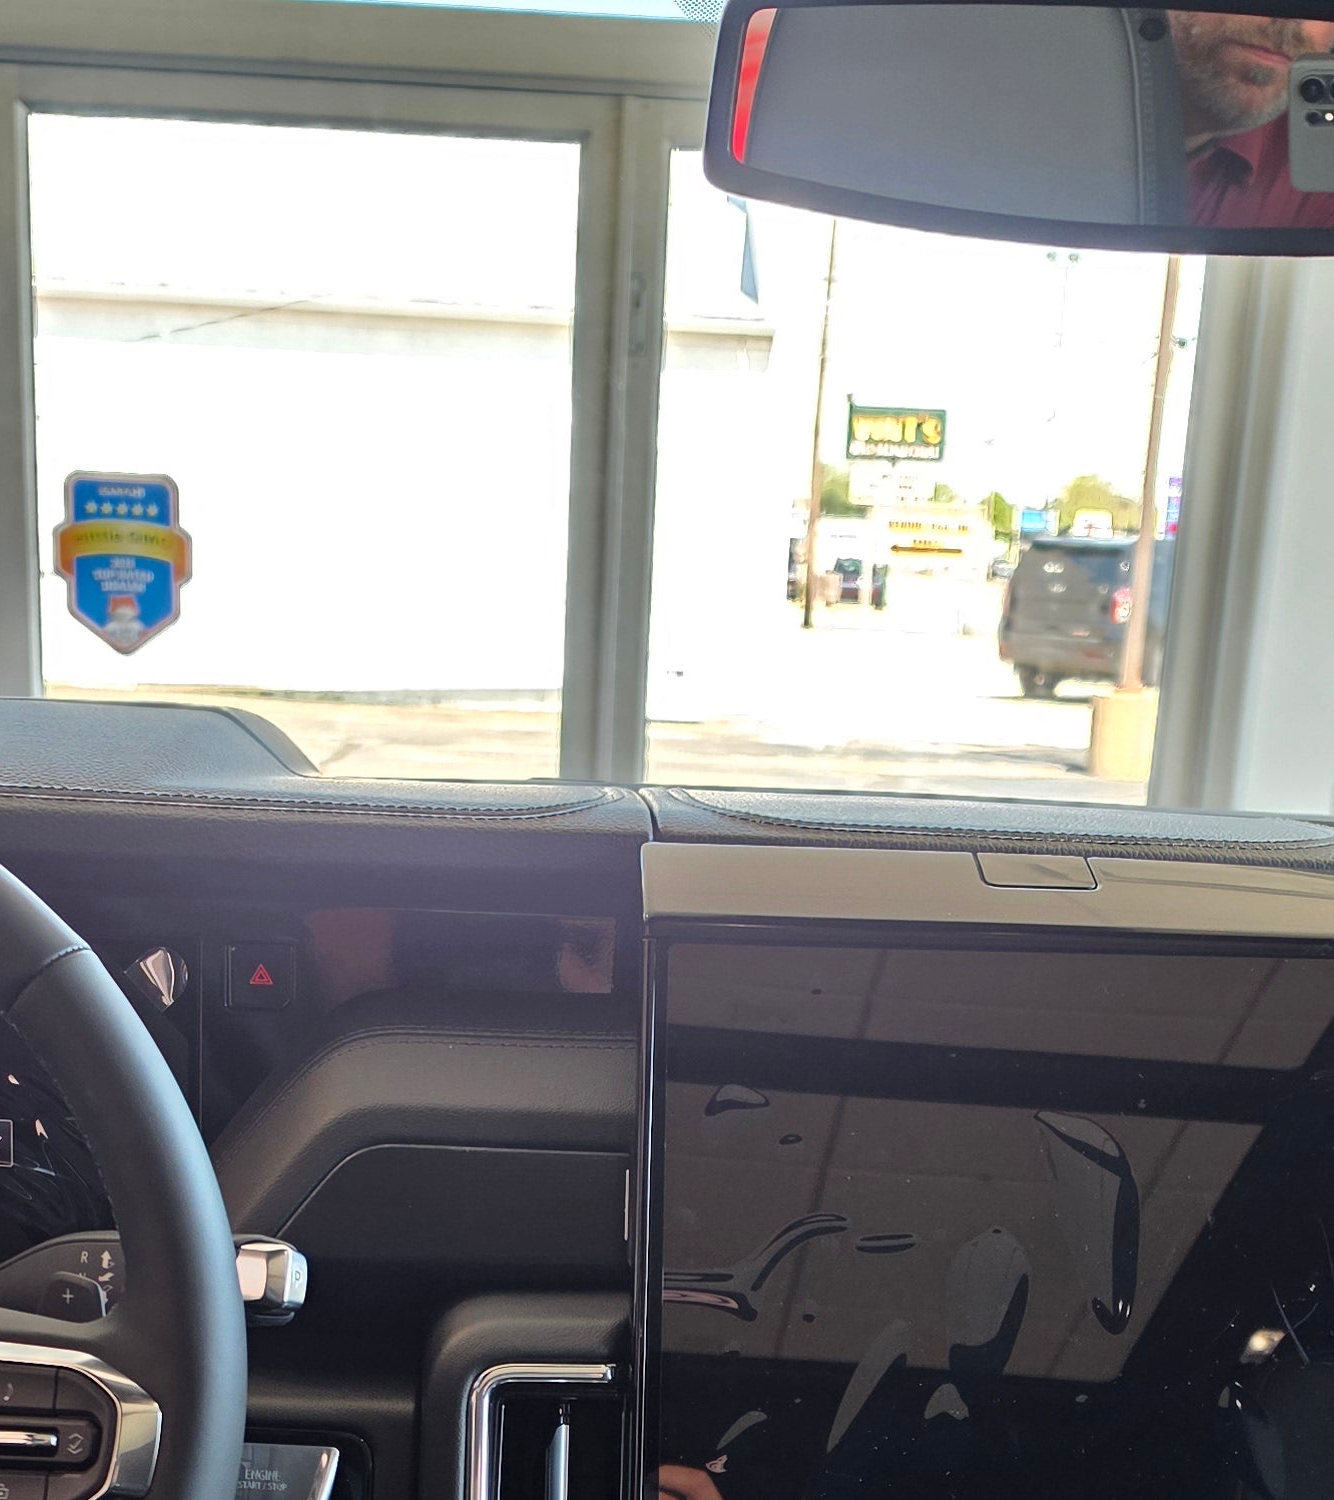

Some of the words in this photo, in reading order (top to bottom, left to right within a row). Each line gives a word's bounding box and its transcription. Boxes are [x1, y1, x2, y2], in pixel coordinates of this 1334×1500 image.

[80, 1250, 89, 1263] R
[245, 1468, 281, 1481] ENGINE
[238, 1481, 261, 1490] START
[267, 1481, 288, 1491] STOP
